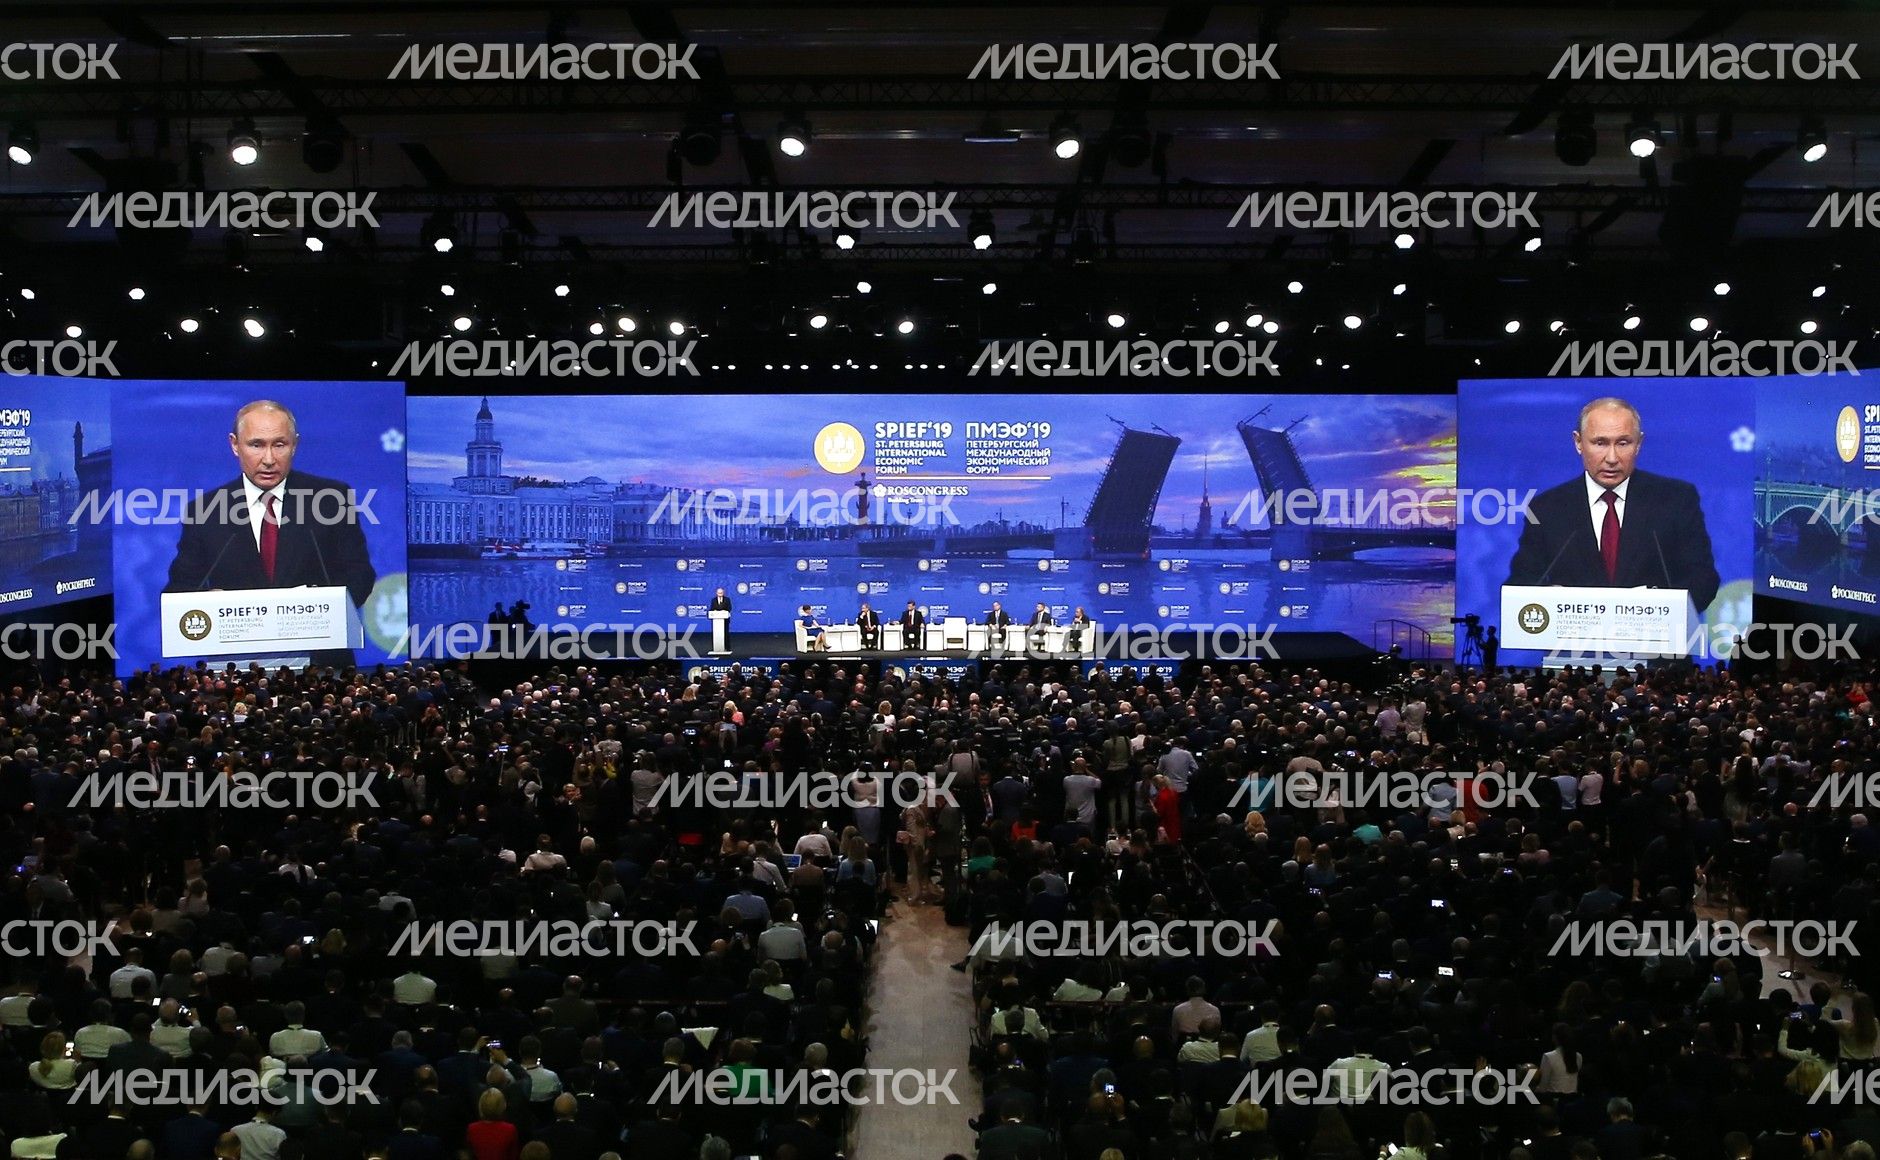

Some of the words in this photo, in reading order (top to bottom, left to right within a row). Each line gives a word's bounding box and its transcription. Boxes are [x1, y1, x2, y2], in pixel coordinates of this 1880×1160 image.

[875, 422, 952, 438] SPIEF'19
[966, 422, 1050, 438] ПМЭФ'19
[875, 440, 887, 448] ST.
[888, 440, 944, 448] PETERSBURG
[966, 440, 1039, 448] ПЕТЕРБУРГСКИЙ
[875, 449, 946, 457] INTERNATIONAL
[966, 448, 1050, 458] МЕЖДУНАРОДНЫЙ
[875, 458, 924, 466] ECONOMIC
[966, 456, 1049, 466] ЭКОНОМИЧЕСКИЙ
[875, 466, 908, 474] FORUM
[966, 466, 1000, 474] ФОРУМ
[887, 486, 968, 496] ROSCONGRESS
[218, 606, 268, 617] SPIEF'19
[276, 604, 330, 614] ПМЭФ'19
[1557, 604, 1606, 614] SPIEF'19
[1615, 605, 1670, 616] ПМЭФ'19
